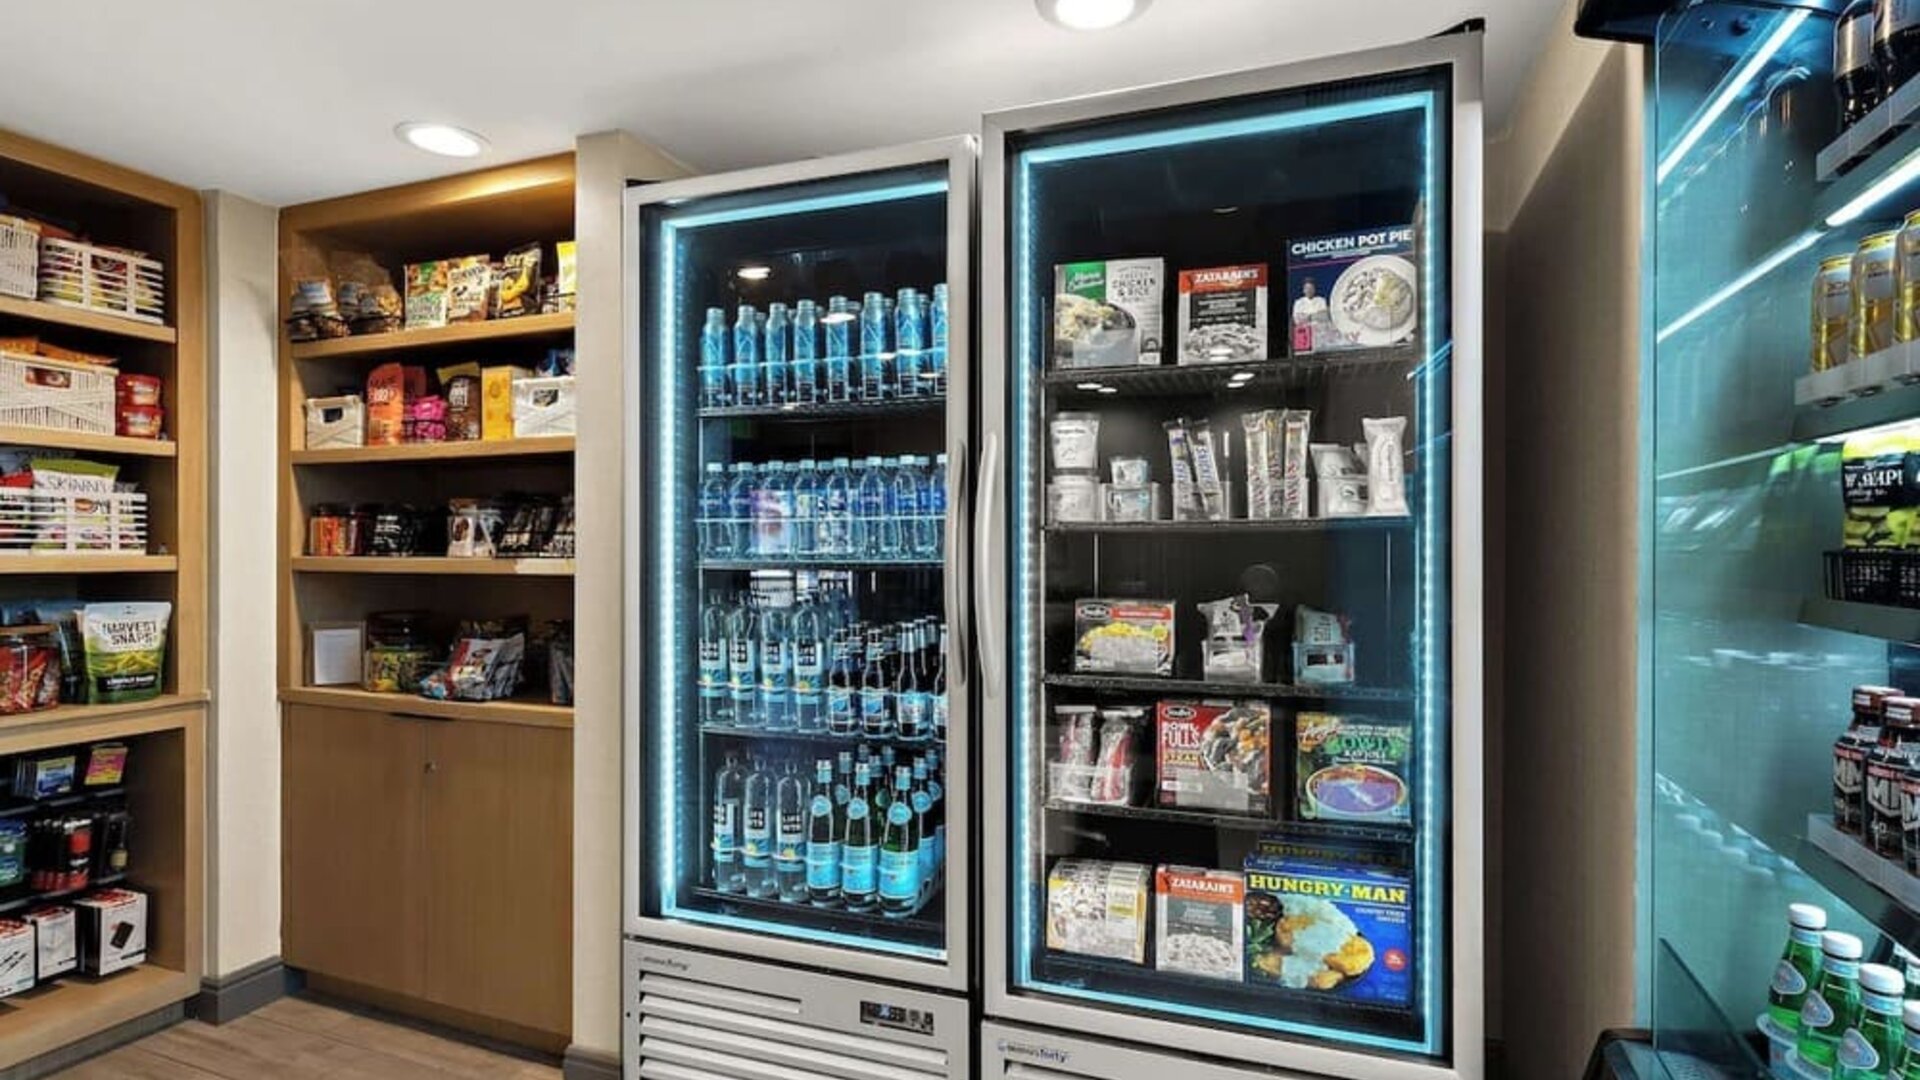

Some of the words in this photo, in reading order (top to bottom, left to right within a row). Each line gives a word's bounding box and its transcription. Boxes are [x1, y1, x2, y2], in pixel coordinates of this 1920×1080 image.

[1291, 237, 1354, 255] CHICKEN
[1358, 232, 1387, 246] POT
[1389, 229, 1412, 241] PIE
[1112, 278, 1156, 289] CHICKEN
[102, 621, 157, 635] HARVEST
[111, 633, 152, 646] SNAPS
